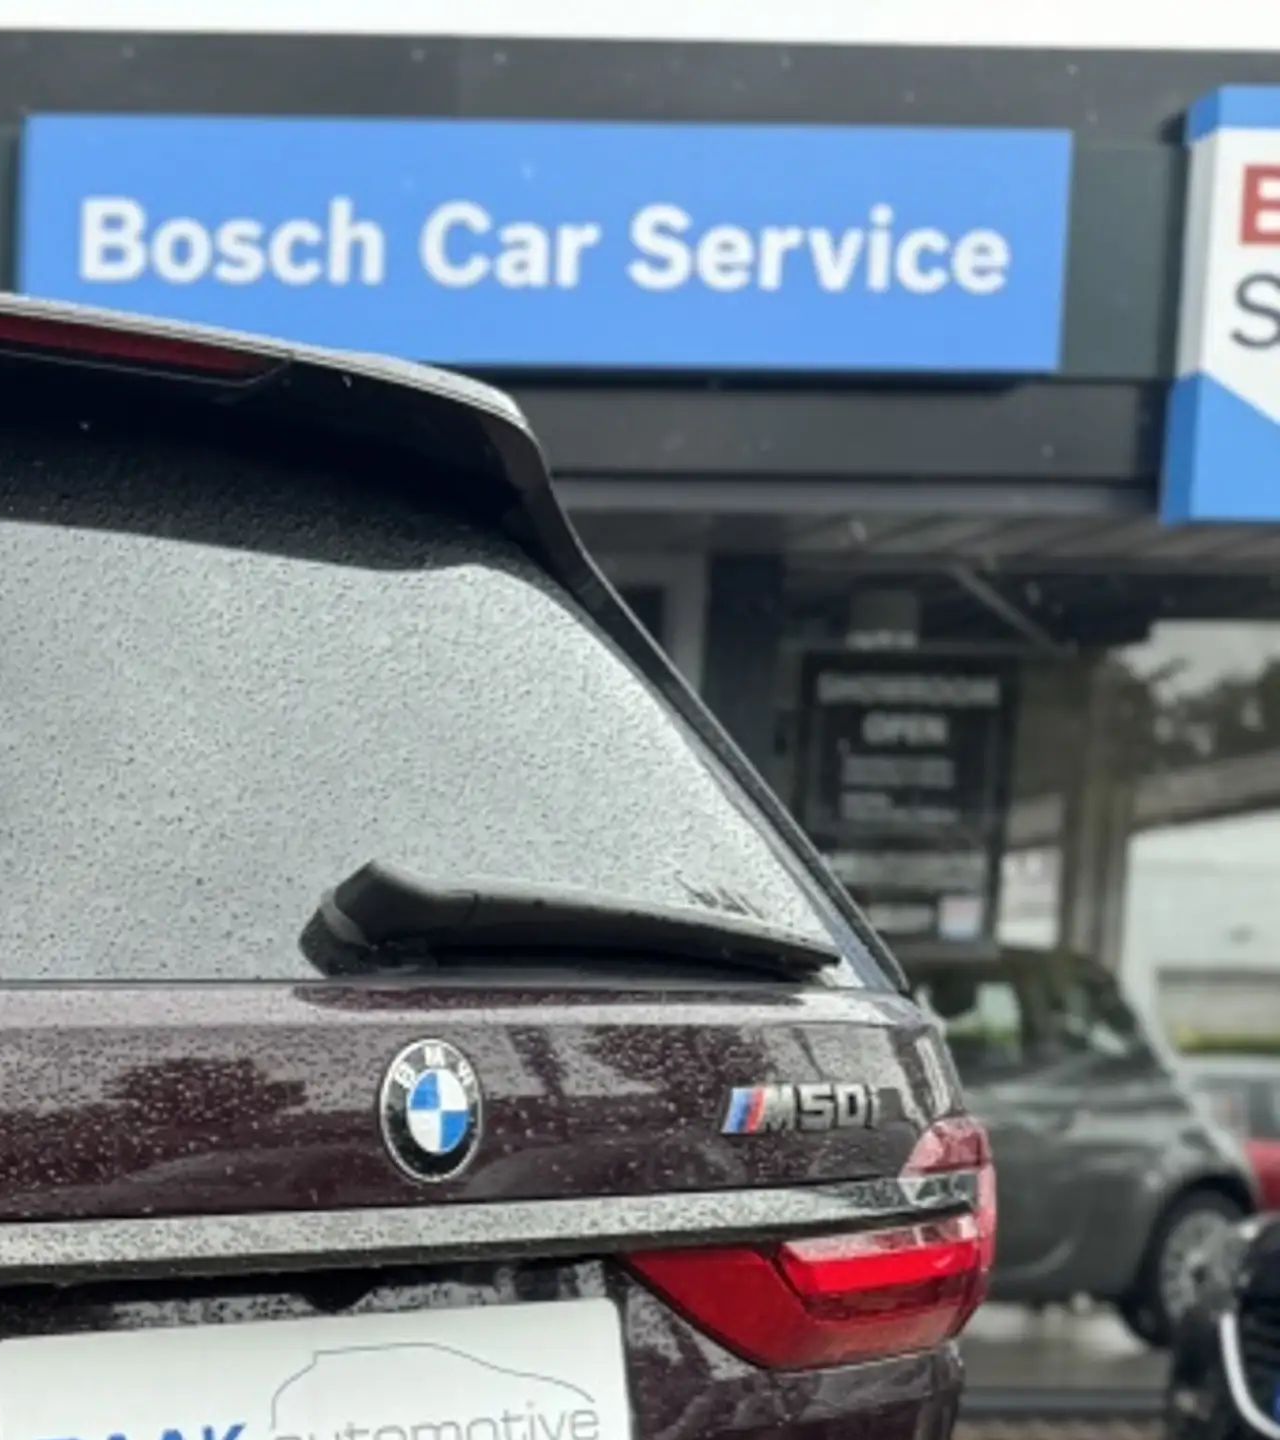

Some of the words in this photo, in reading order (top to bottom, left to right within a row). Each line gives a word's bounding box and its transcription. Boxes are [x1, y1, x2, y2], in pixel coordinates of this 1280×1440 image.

[77, 196, 385, 286] Bosch
[419, 201, 600, 289] Car
[627, 203, 1011, 294] Service
